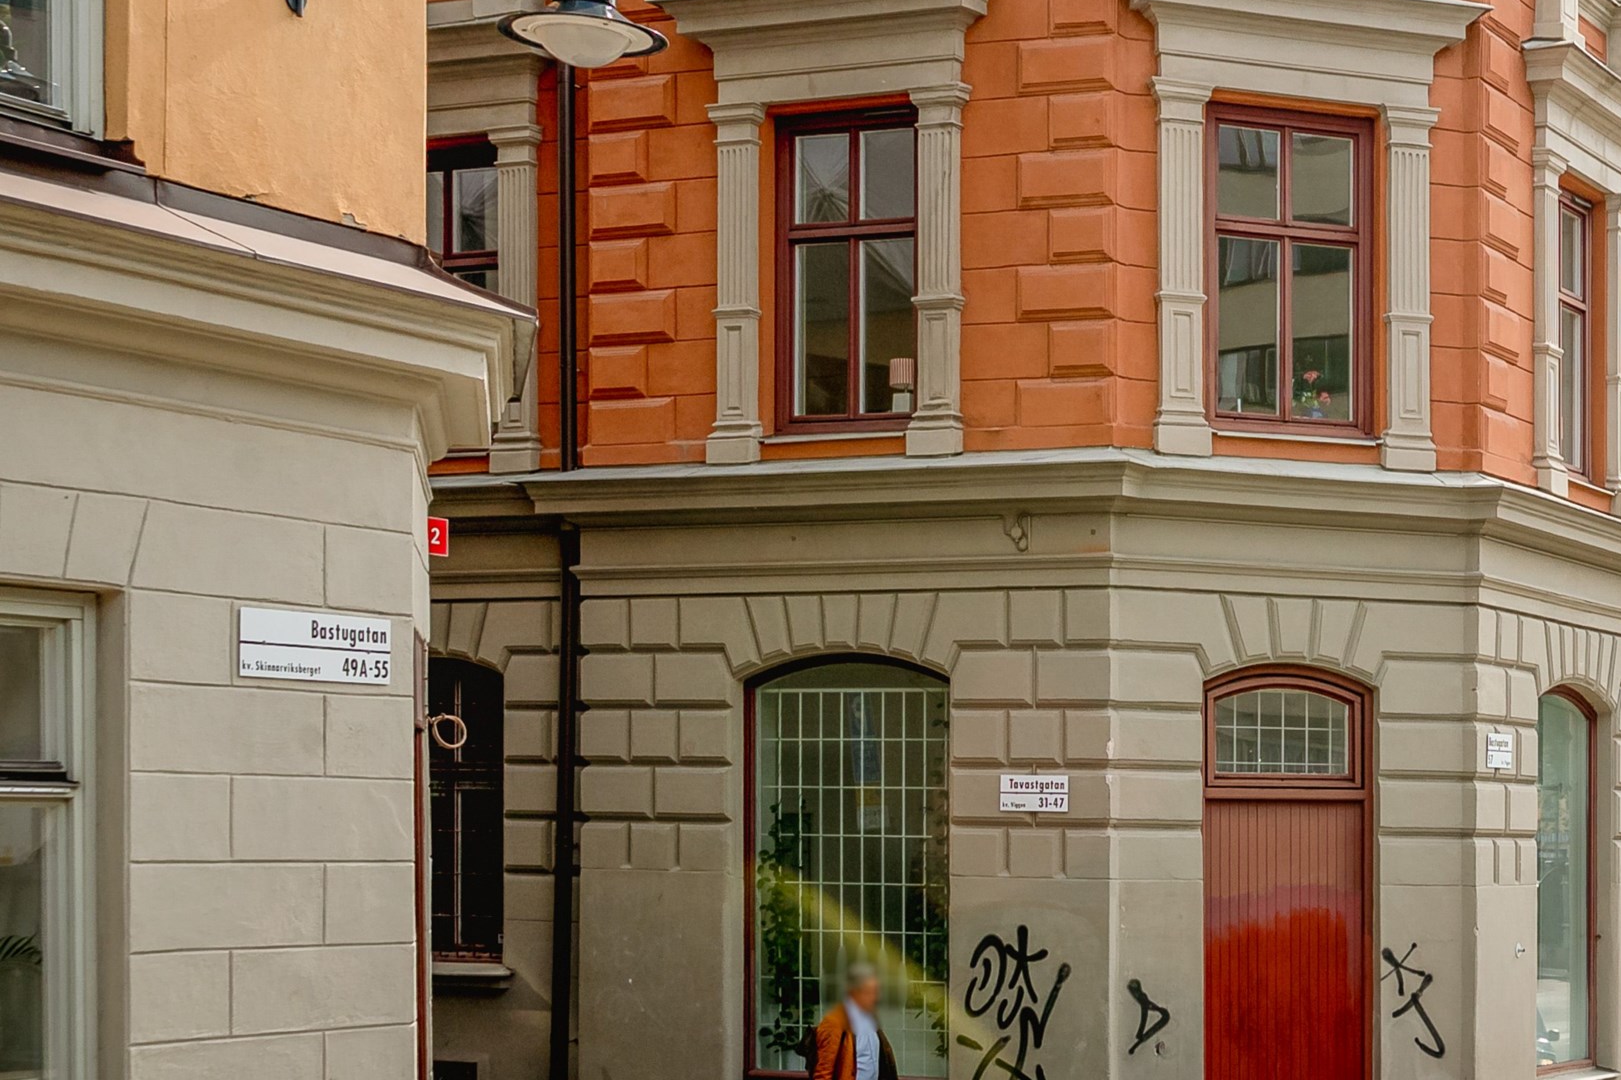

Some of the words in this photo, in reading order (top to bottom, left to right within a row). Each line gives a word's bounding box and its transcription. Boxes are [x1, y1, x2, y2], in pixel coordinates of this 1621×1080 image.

[311, 619, 388, 648] Bastugatan
[241, 660, 254, 671] kv.
[255, 661, 321, 677] Skinnarviksberget
[342, 658, 389, 679] 49A-55
[1008, 778, 1066, 793] Tavastgatan
[1038, 797, 1065, 808] 31-47
